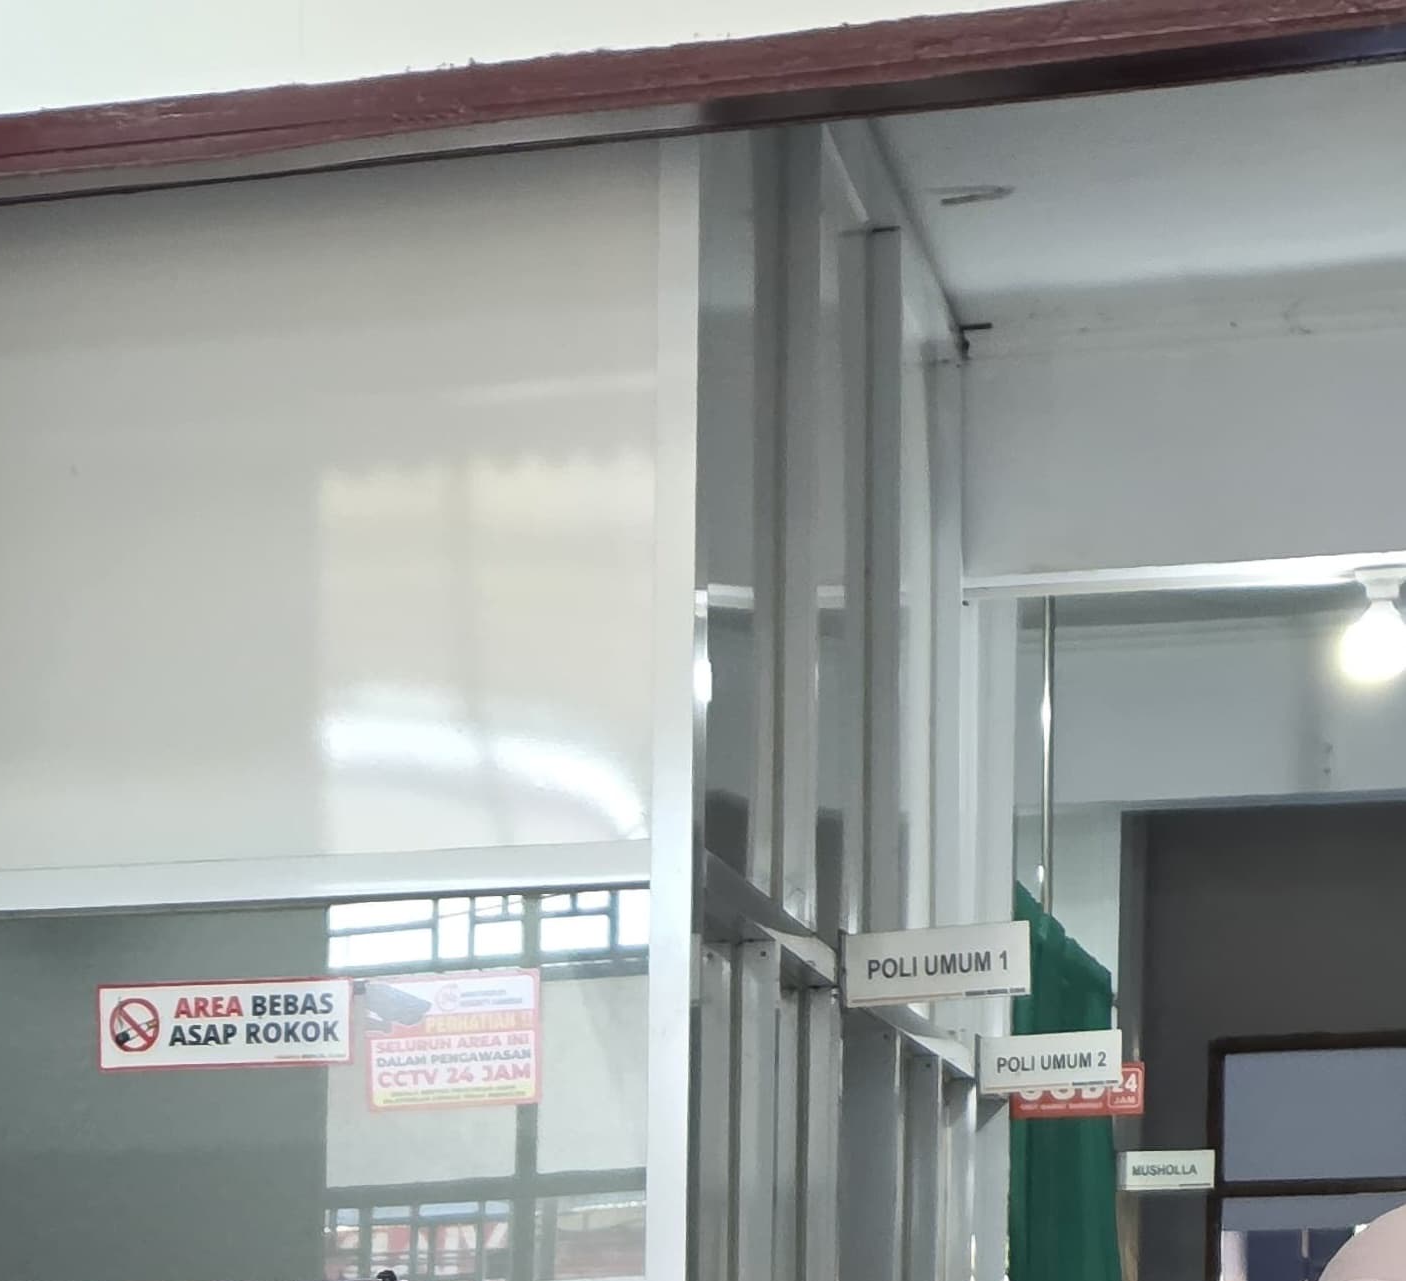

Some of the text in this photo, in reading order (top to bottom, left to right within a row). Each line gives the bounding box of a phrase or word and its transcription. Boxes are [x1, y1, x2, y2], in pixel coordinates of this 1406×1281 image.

[867, 950, 1009, 980] POLI UMUM 1
[173, 992, 334, 1019] AREA BEBAS
[168, 1020, 339, 1047] ASAP ROKOK
[457, 1035, 504, 1049] AREA
[507, 1033, 529, 1046] INI
[376, 1049, 531, 1068] DALAM PENGAWASAN
[997, 1051, 1107, 1073] POLI UMUM 2
[377, 1063, 531, 1088] CCTV 24 JAM
[1131, 1163, 1198, 1177] MUSHOLLA
